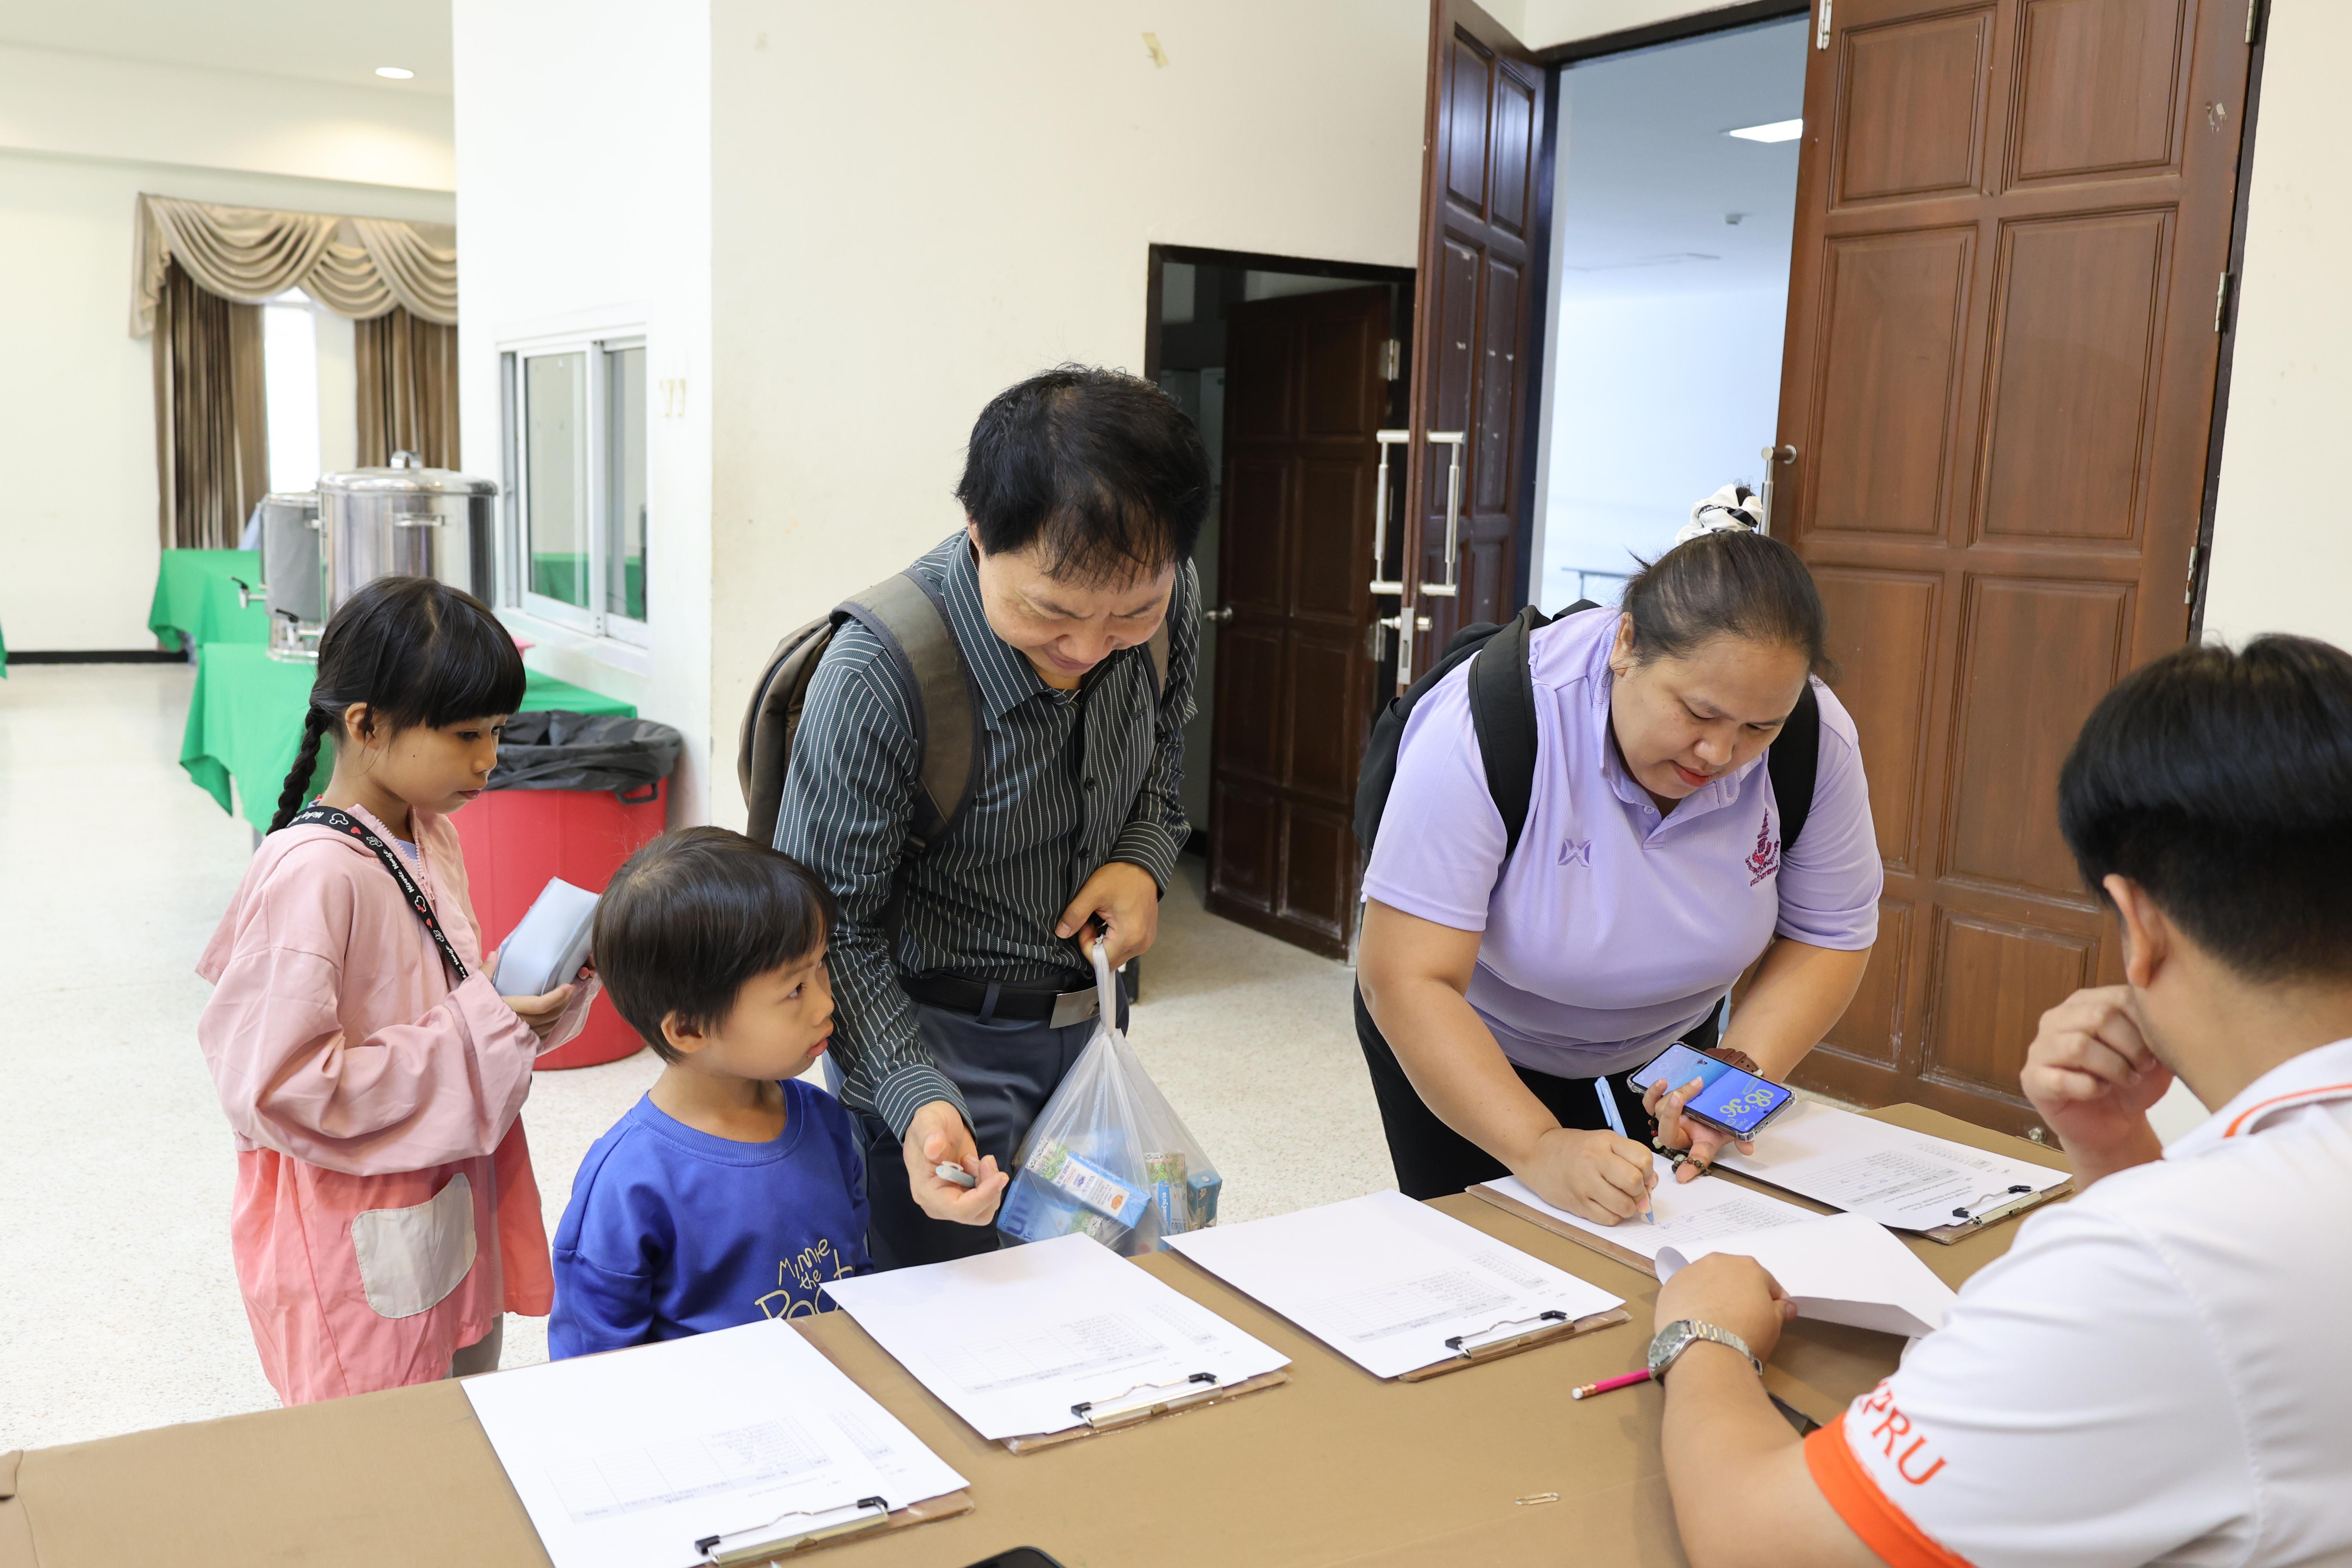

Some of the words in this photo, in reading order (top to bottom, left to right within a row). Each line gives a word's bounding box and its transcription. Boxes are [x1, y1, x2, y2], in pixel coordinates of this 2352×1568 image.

[382, 848, 400, 870] Mouse
[397, 869, 415, 893] Minnie
[445, 944, 460, 965] Mouse
[1720, 1089, 1774, 1117] 08:36
[800, 1268, 821, 1290] the
[1859, 1381, 1947, 1486] PRU
